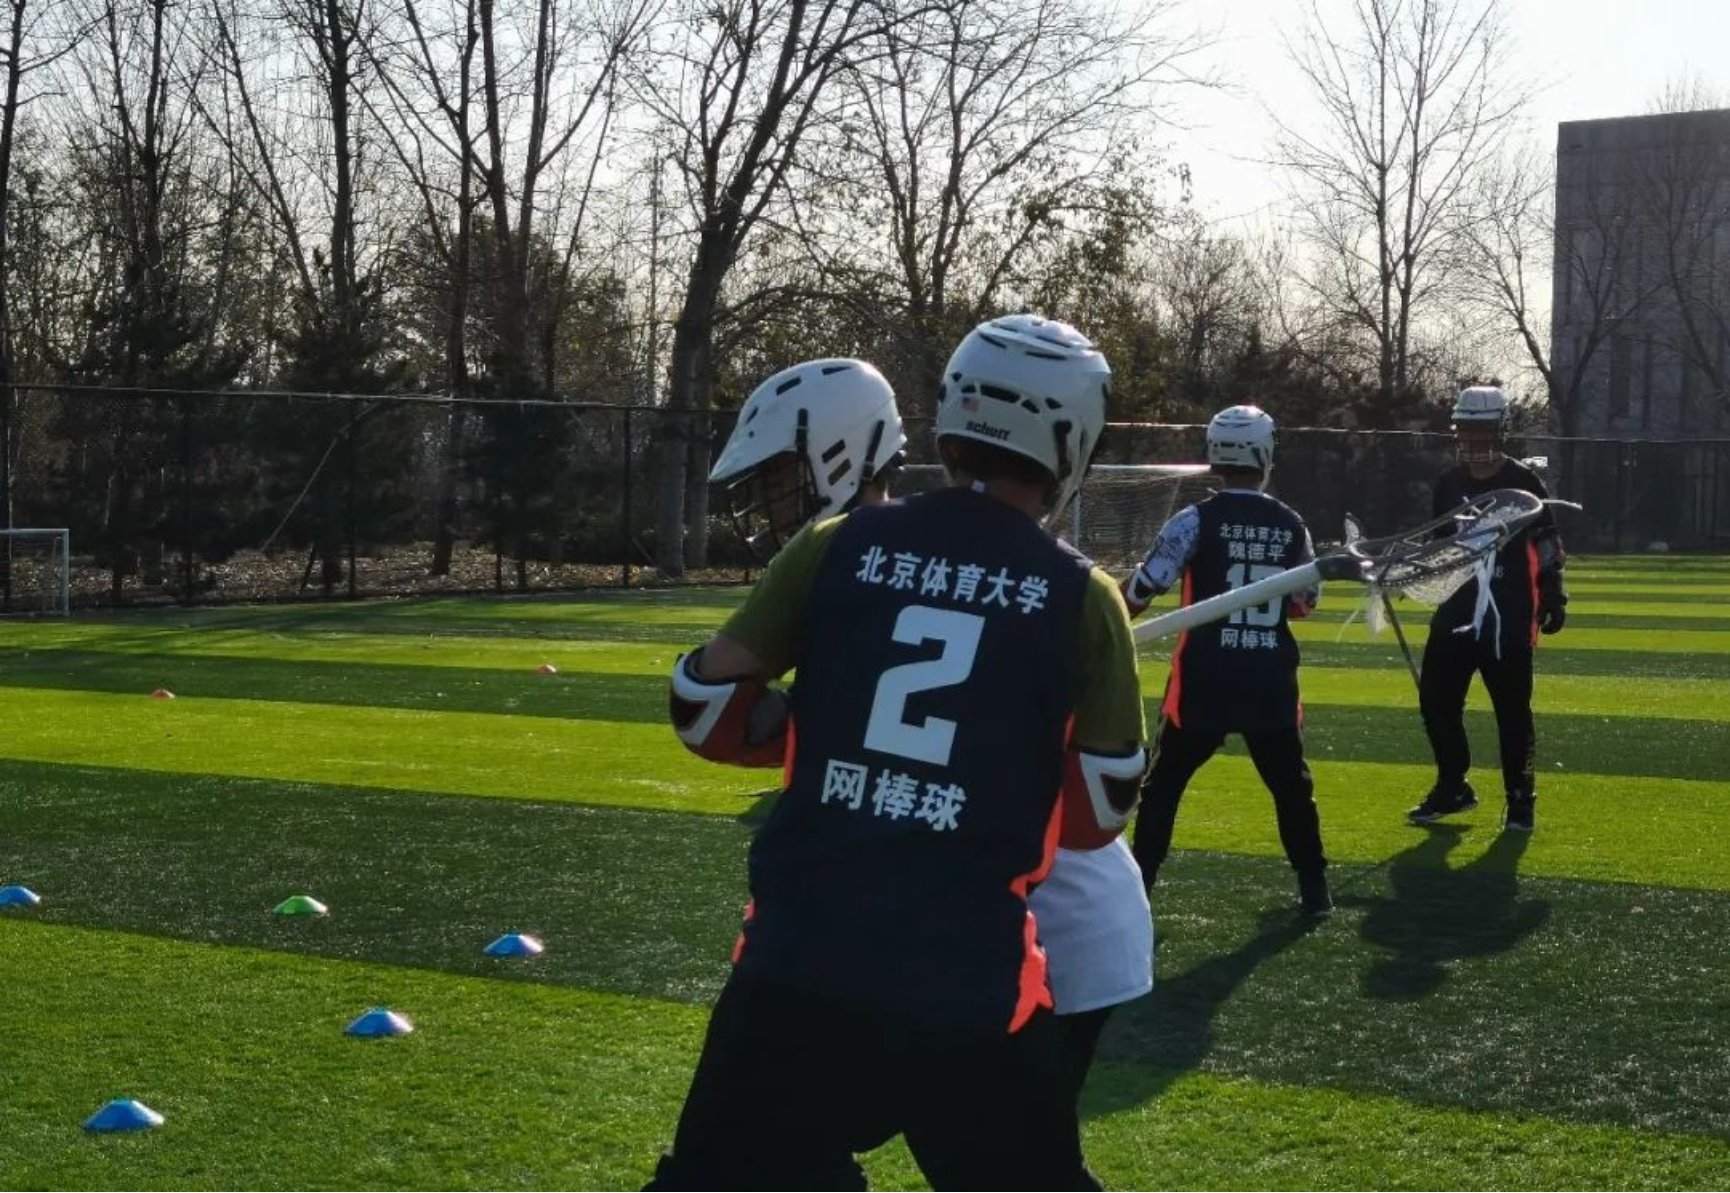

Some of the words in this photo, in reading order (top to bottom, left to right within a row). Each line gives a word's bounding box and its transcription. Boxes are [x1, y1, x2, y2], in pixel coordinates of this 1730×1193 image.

[1220, 522, 1293, 545] 北京体育大学
[856, 546, 1048, 614] 北京体育大学
[1220, 628, 1278, 648] 网棒球
[863, 605, 986, 766] 2
[821, 759, 966, 832] 网棒球
